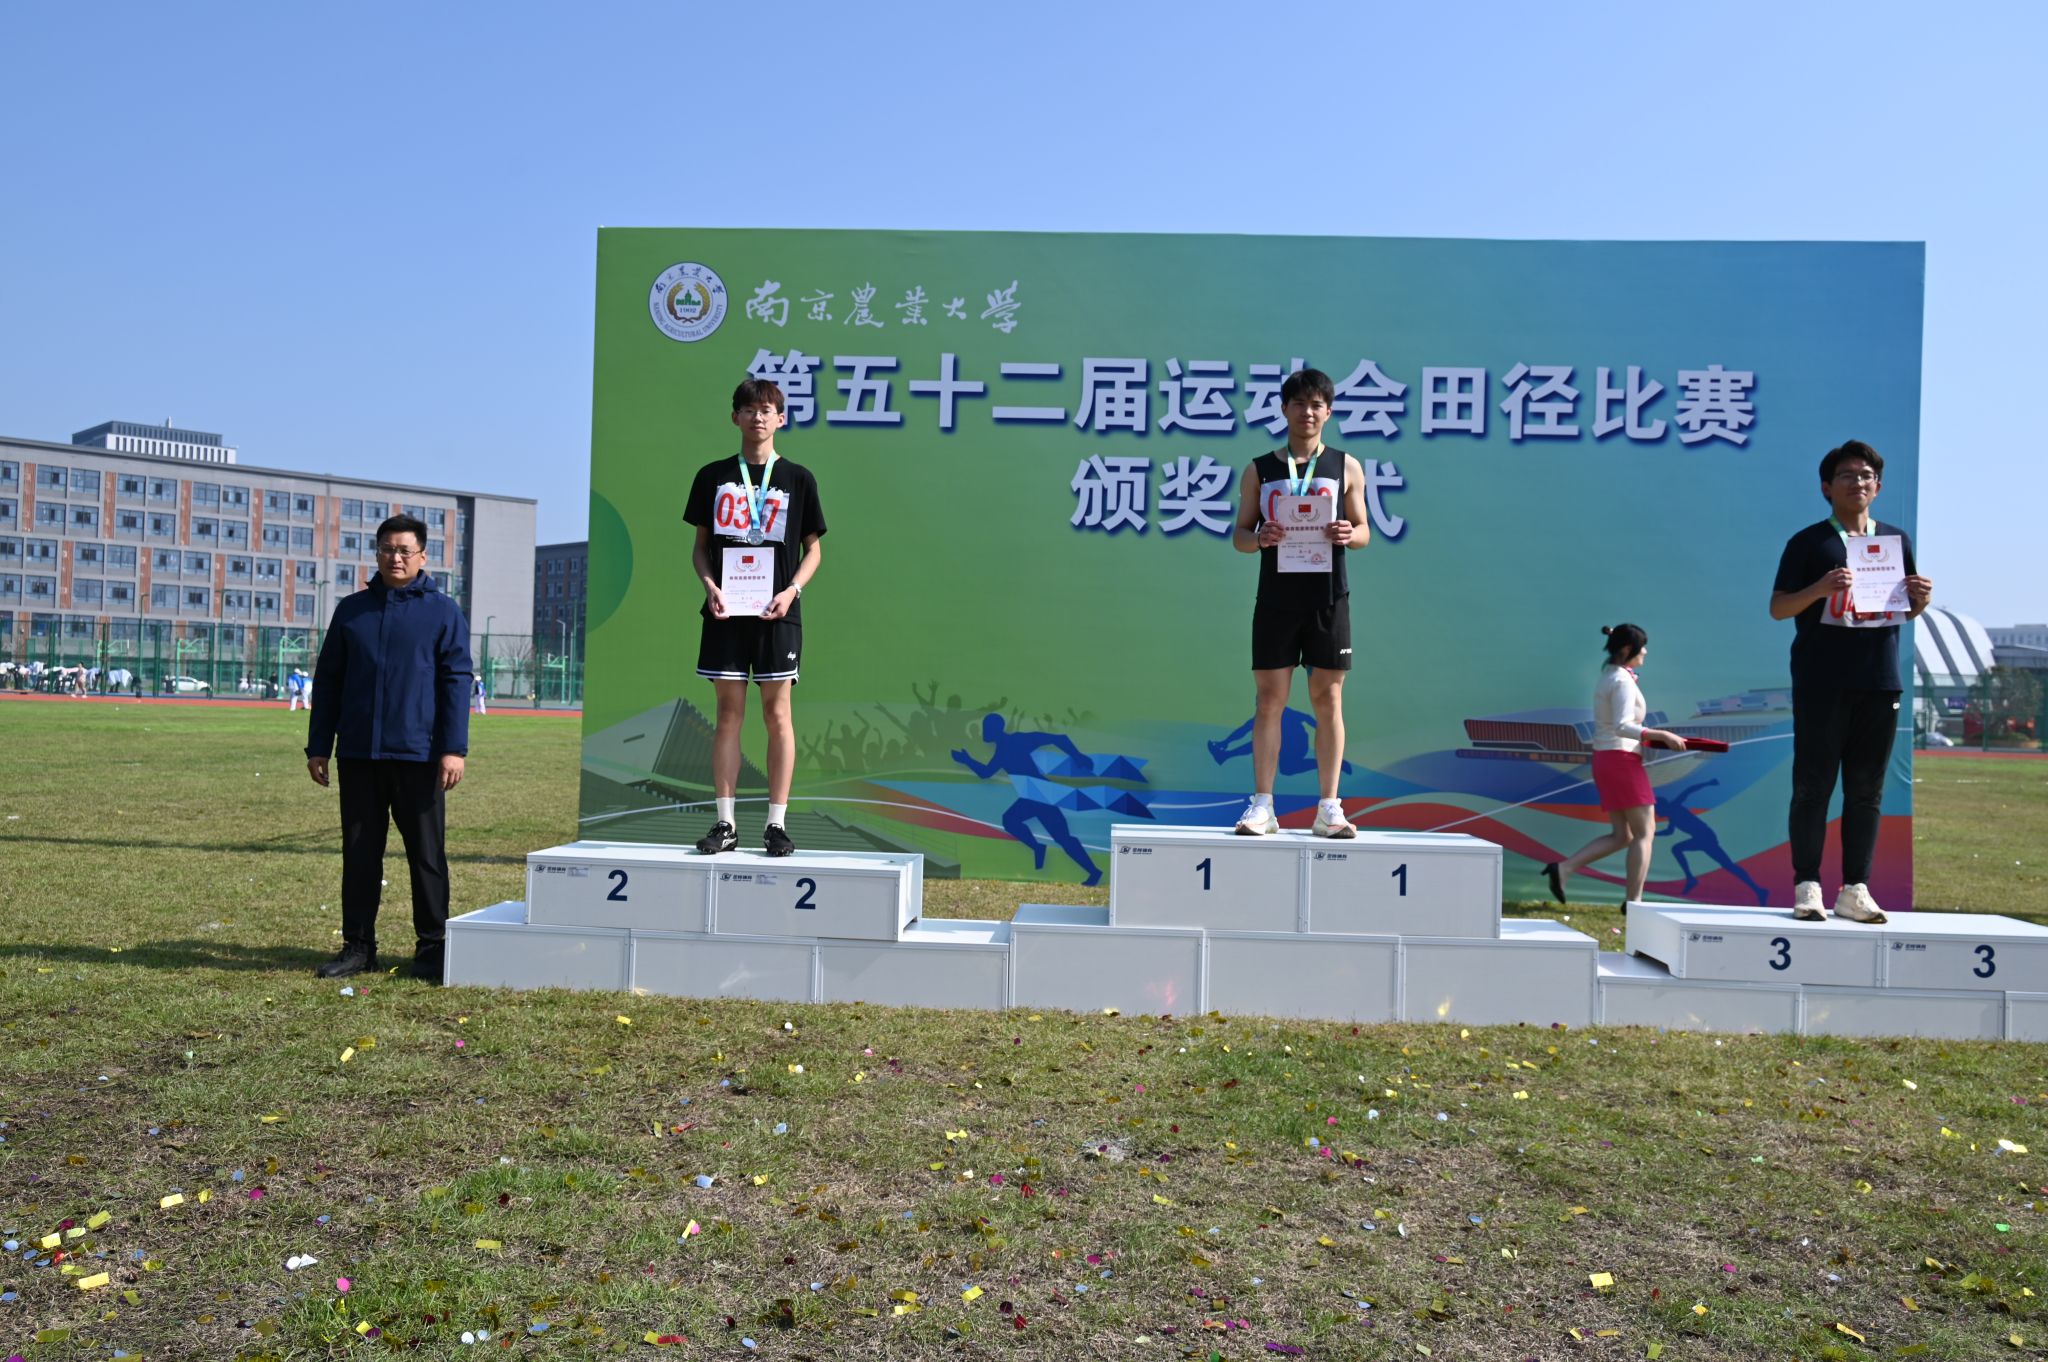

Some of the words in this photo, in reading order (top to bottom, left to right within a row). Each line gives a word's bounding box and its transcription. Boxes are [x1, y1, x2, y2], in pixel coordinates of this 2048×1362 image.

[746, 348, 1755, 445] 第五十二届运动会田径比赛
[716, 492, 781, 534] 037
[606, 869, 628, 902] 2
[1195, 857, 1211, 890] 1
[1391, 863, 1407, 896] 1
[794, 877, 816, 910] 2
[1768, 936, 1792, 971] 3
[1972, 944, 1996, 978] 3
